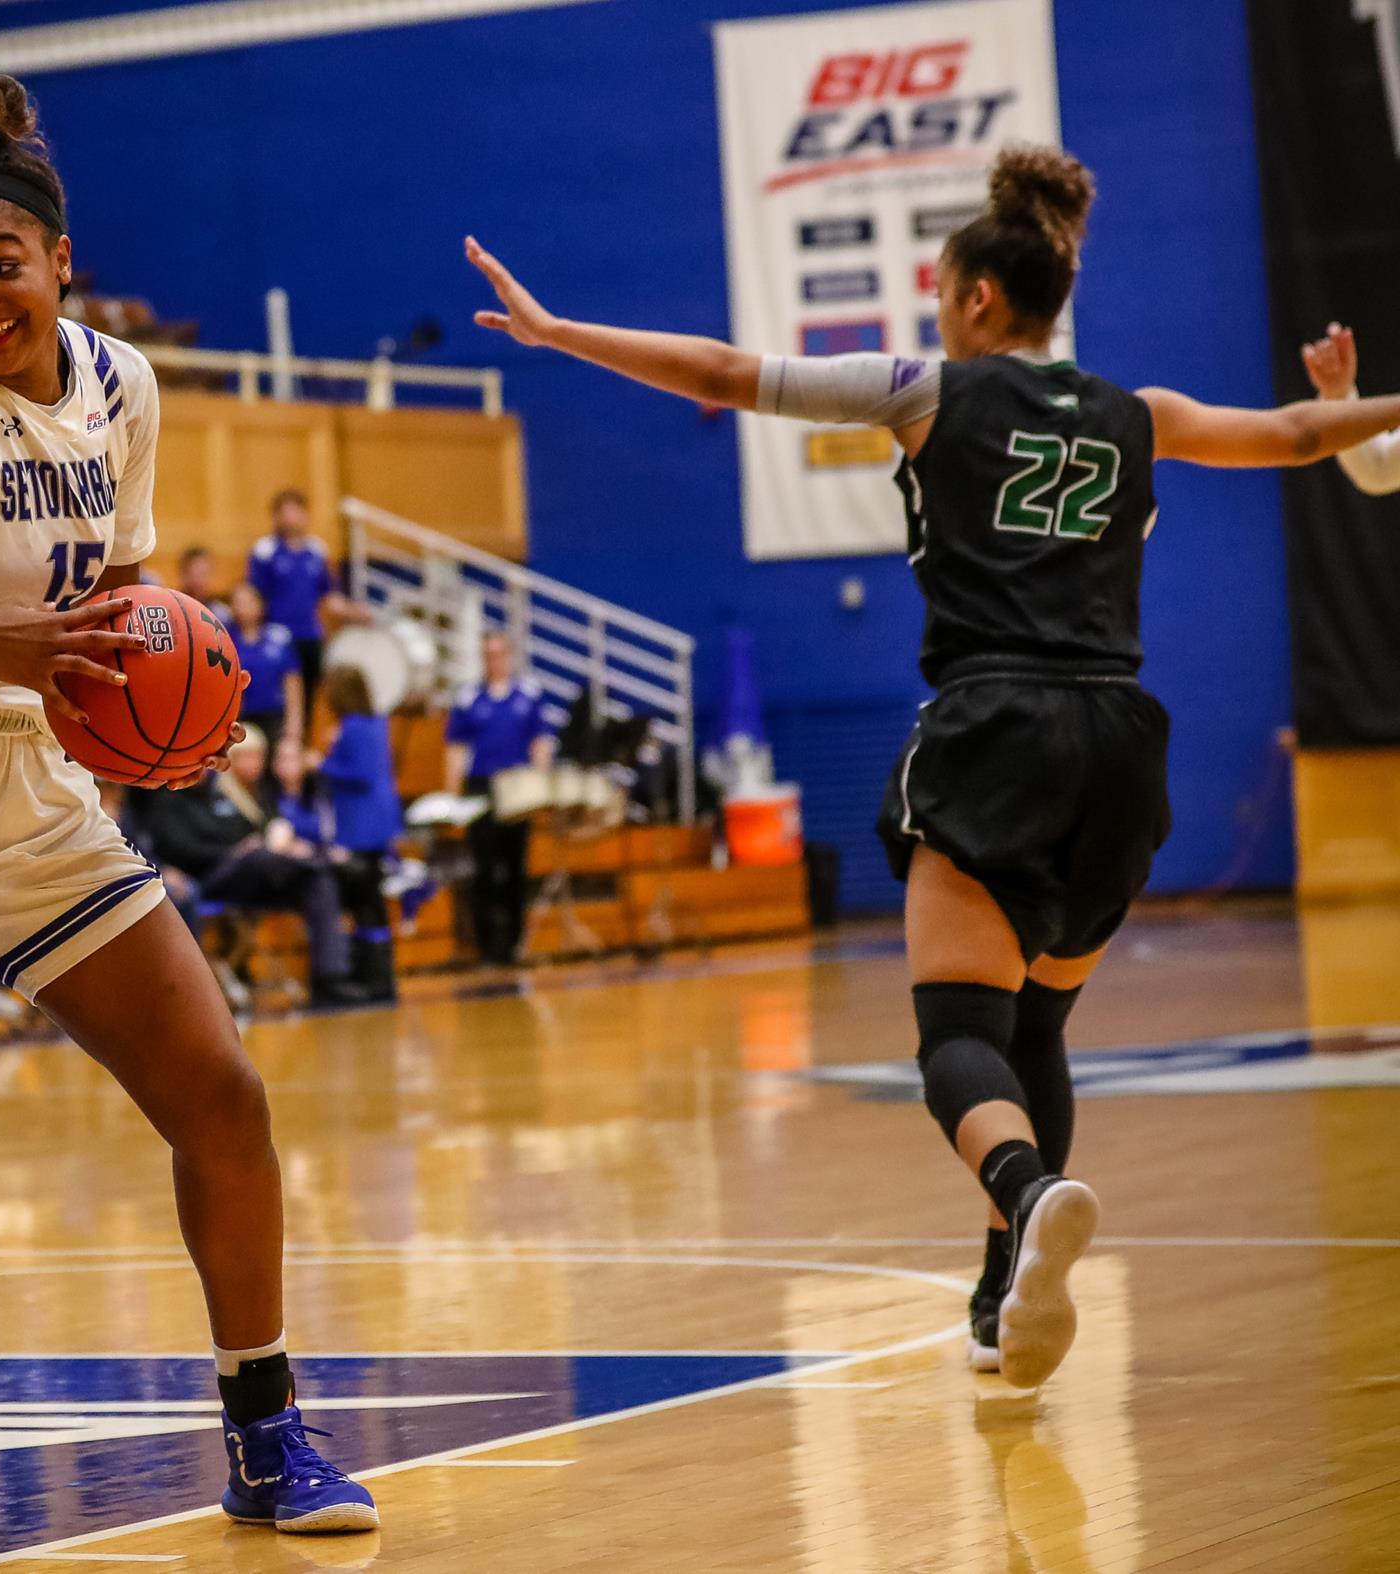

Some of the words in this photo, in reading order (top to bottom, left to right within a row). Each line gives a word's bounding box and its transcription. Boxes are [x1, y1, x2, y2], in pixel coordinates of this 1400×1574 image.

[807, 41, 970, 105] BIG
[783, 89, 1018, 161] EAST
[87, 411, 101, 422] BIG
[87, 417, 107, 431] EAST
[0, 458, 87, 524] SETON
[992, 430, 1121, 541] 22
[43, 540, 105, 613] 15
